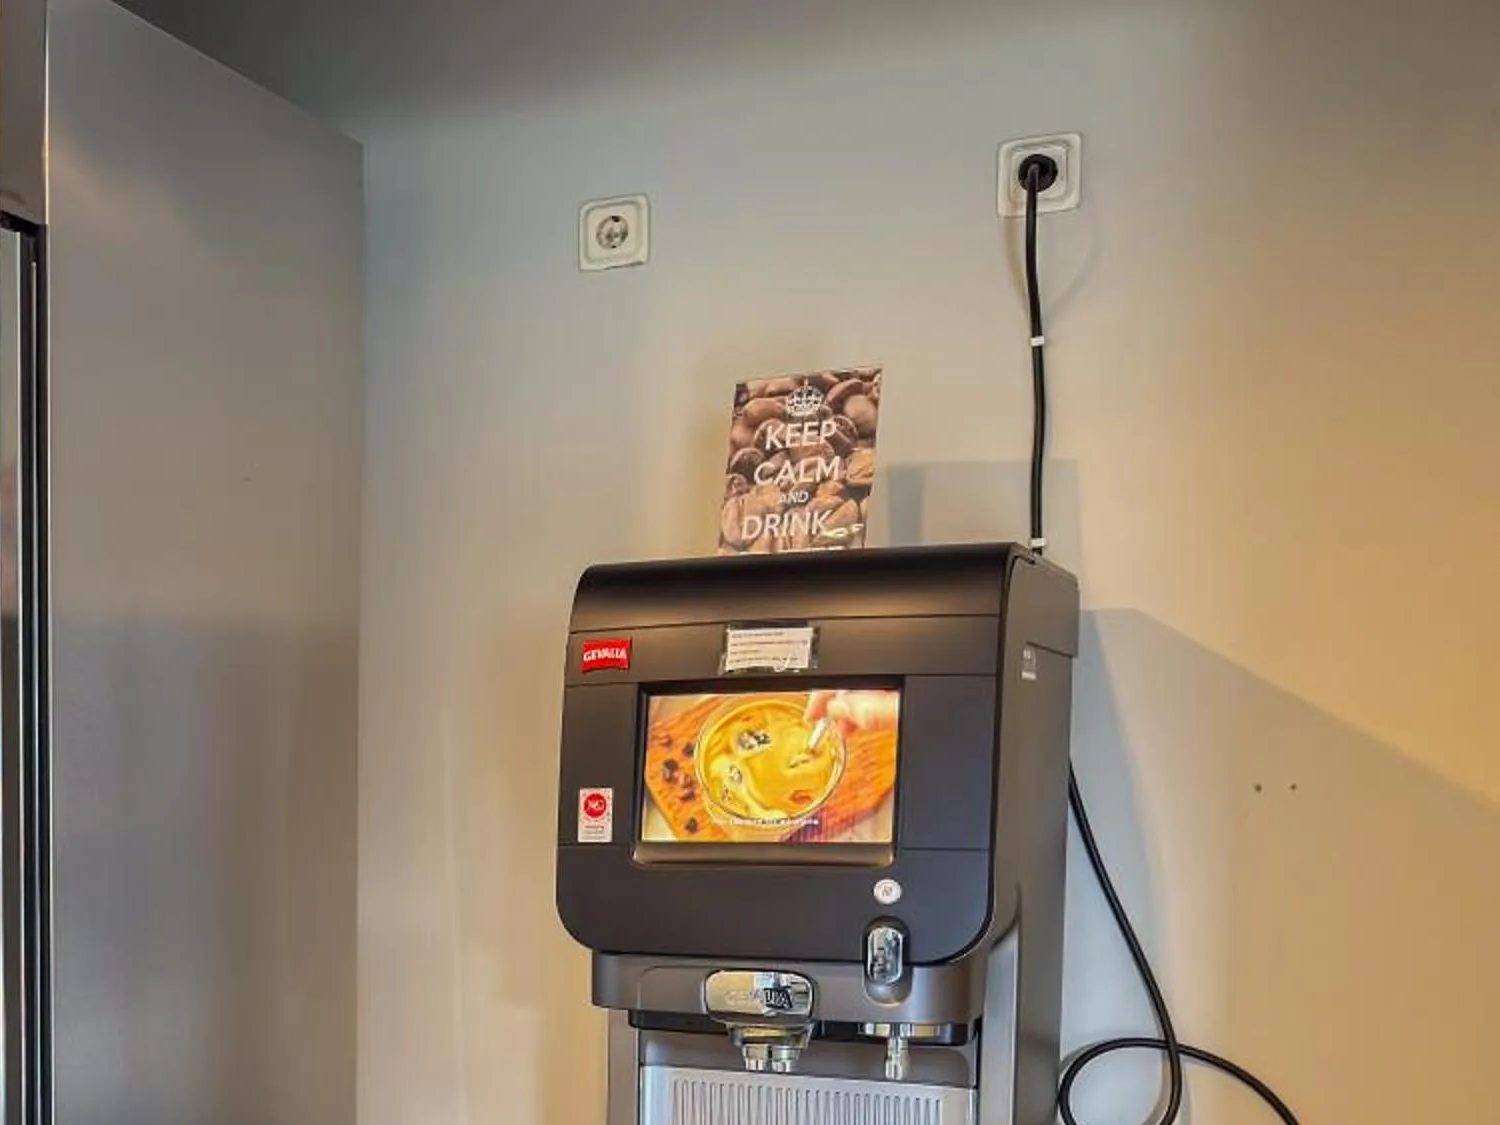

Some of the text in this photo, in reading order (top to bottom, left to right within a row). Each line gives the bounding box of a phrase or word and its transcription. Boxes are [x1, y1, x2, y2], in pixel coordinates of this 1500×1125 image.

[765, 419, 837, 450] KEEP
[753, 455, 842, 486] CALM
[778, 491, 809, 505] AND
[741, 508, 833, 540] DRINK
